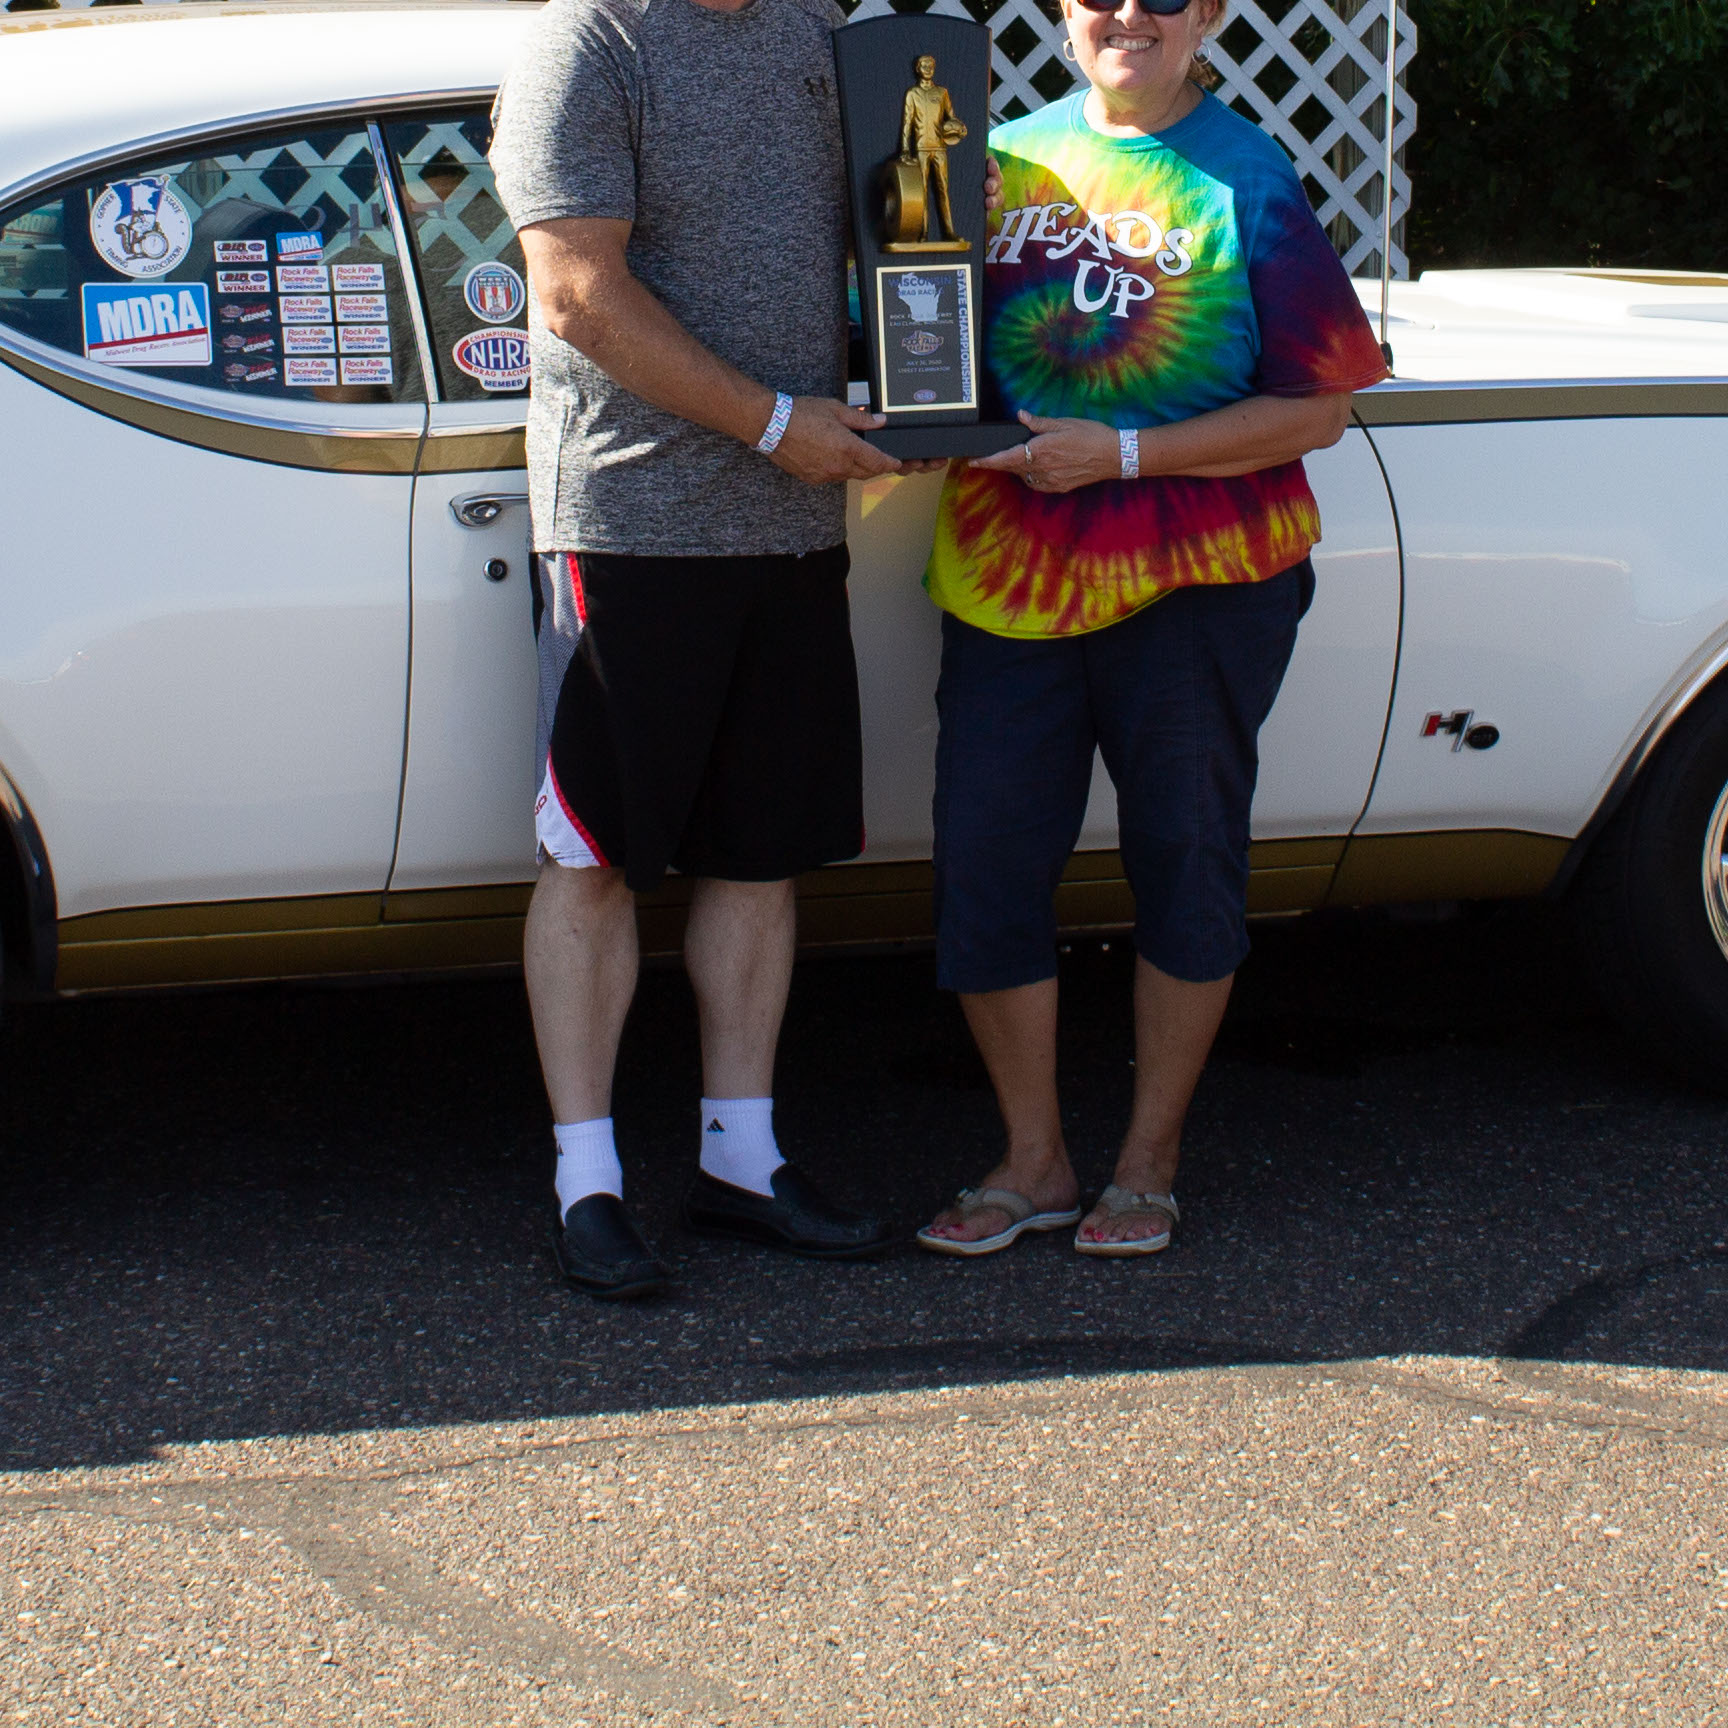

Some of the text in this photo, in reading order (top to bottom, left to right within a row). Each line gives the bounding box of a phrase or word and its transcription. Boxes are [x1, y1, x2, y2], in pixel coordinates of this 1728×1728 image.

[985, 201, 1195, 276] HEADS
[97, 289, 206, 343] MDRA
[1073, 258, 1155, 318] UP
[483, 378, 523, 388] MEMBER
[958, 306, 972, 403] CHAMPIONSHIPS
